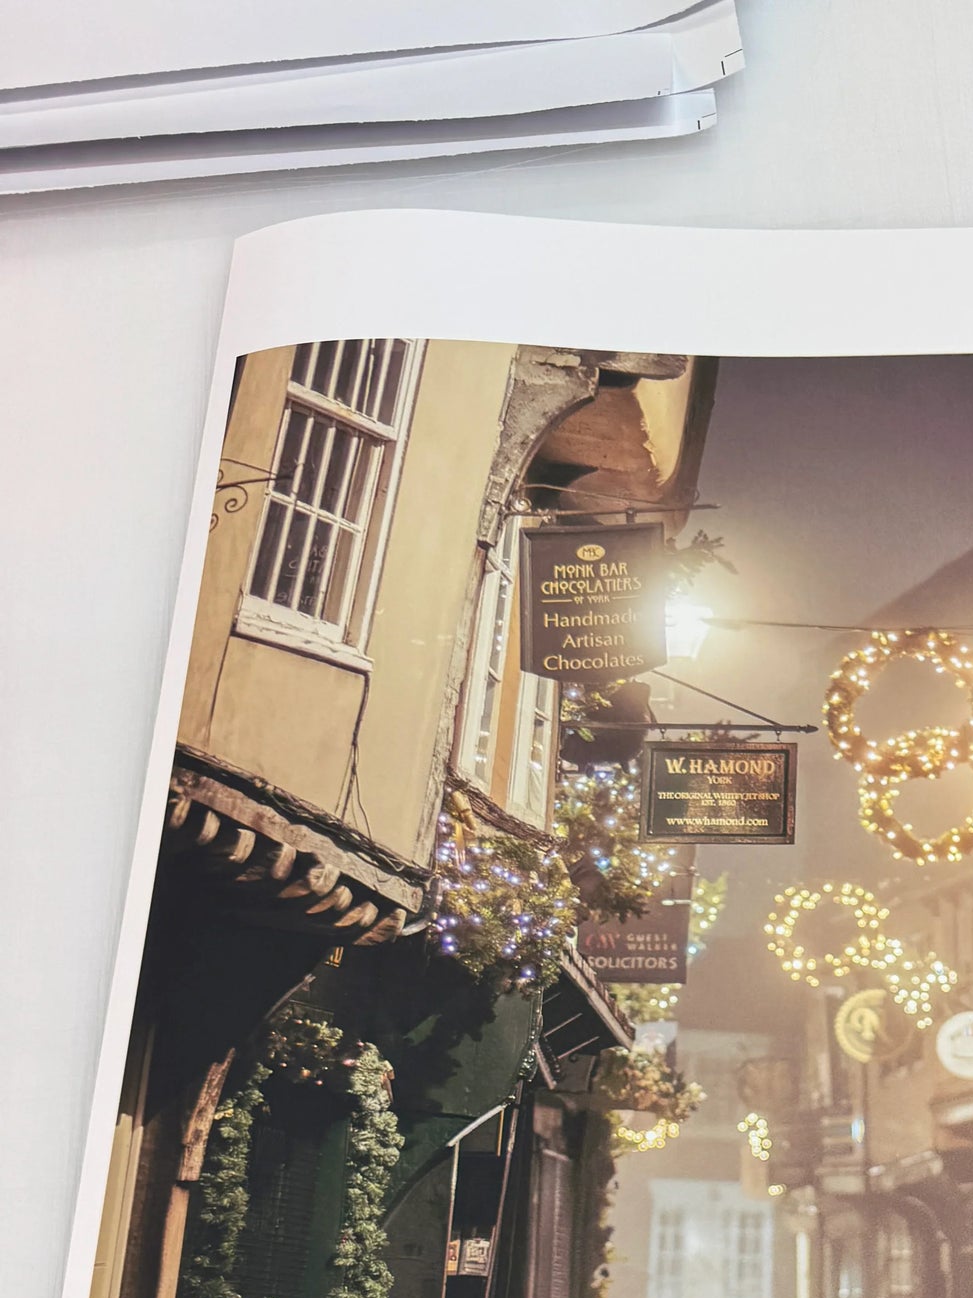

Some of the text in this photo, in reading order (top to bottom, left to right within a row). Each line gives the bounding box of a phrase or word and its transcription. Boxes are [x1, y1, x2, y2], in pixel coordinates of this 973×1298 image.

[554, 562, 628, 579] MONK BAR
[541, 577, 642, 595] CHOCOLATIERS
[562, 633, 625, 649] Artisan
[543, 653, 645, 671] Chocolates
[689, 759, 775, 775] HAMOND
[707, 775, 733, 785] YORK
